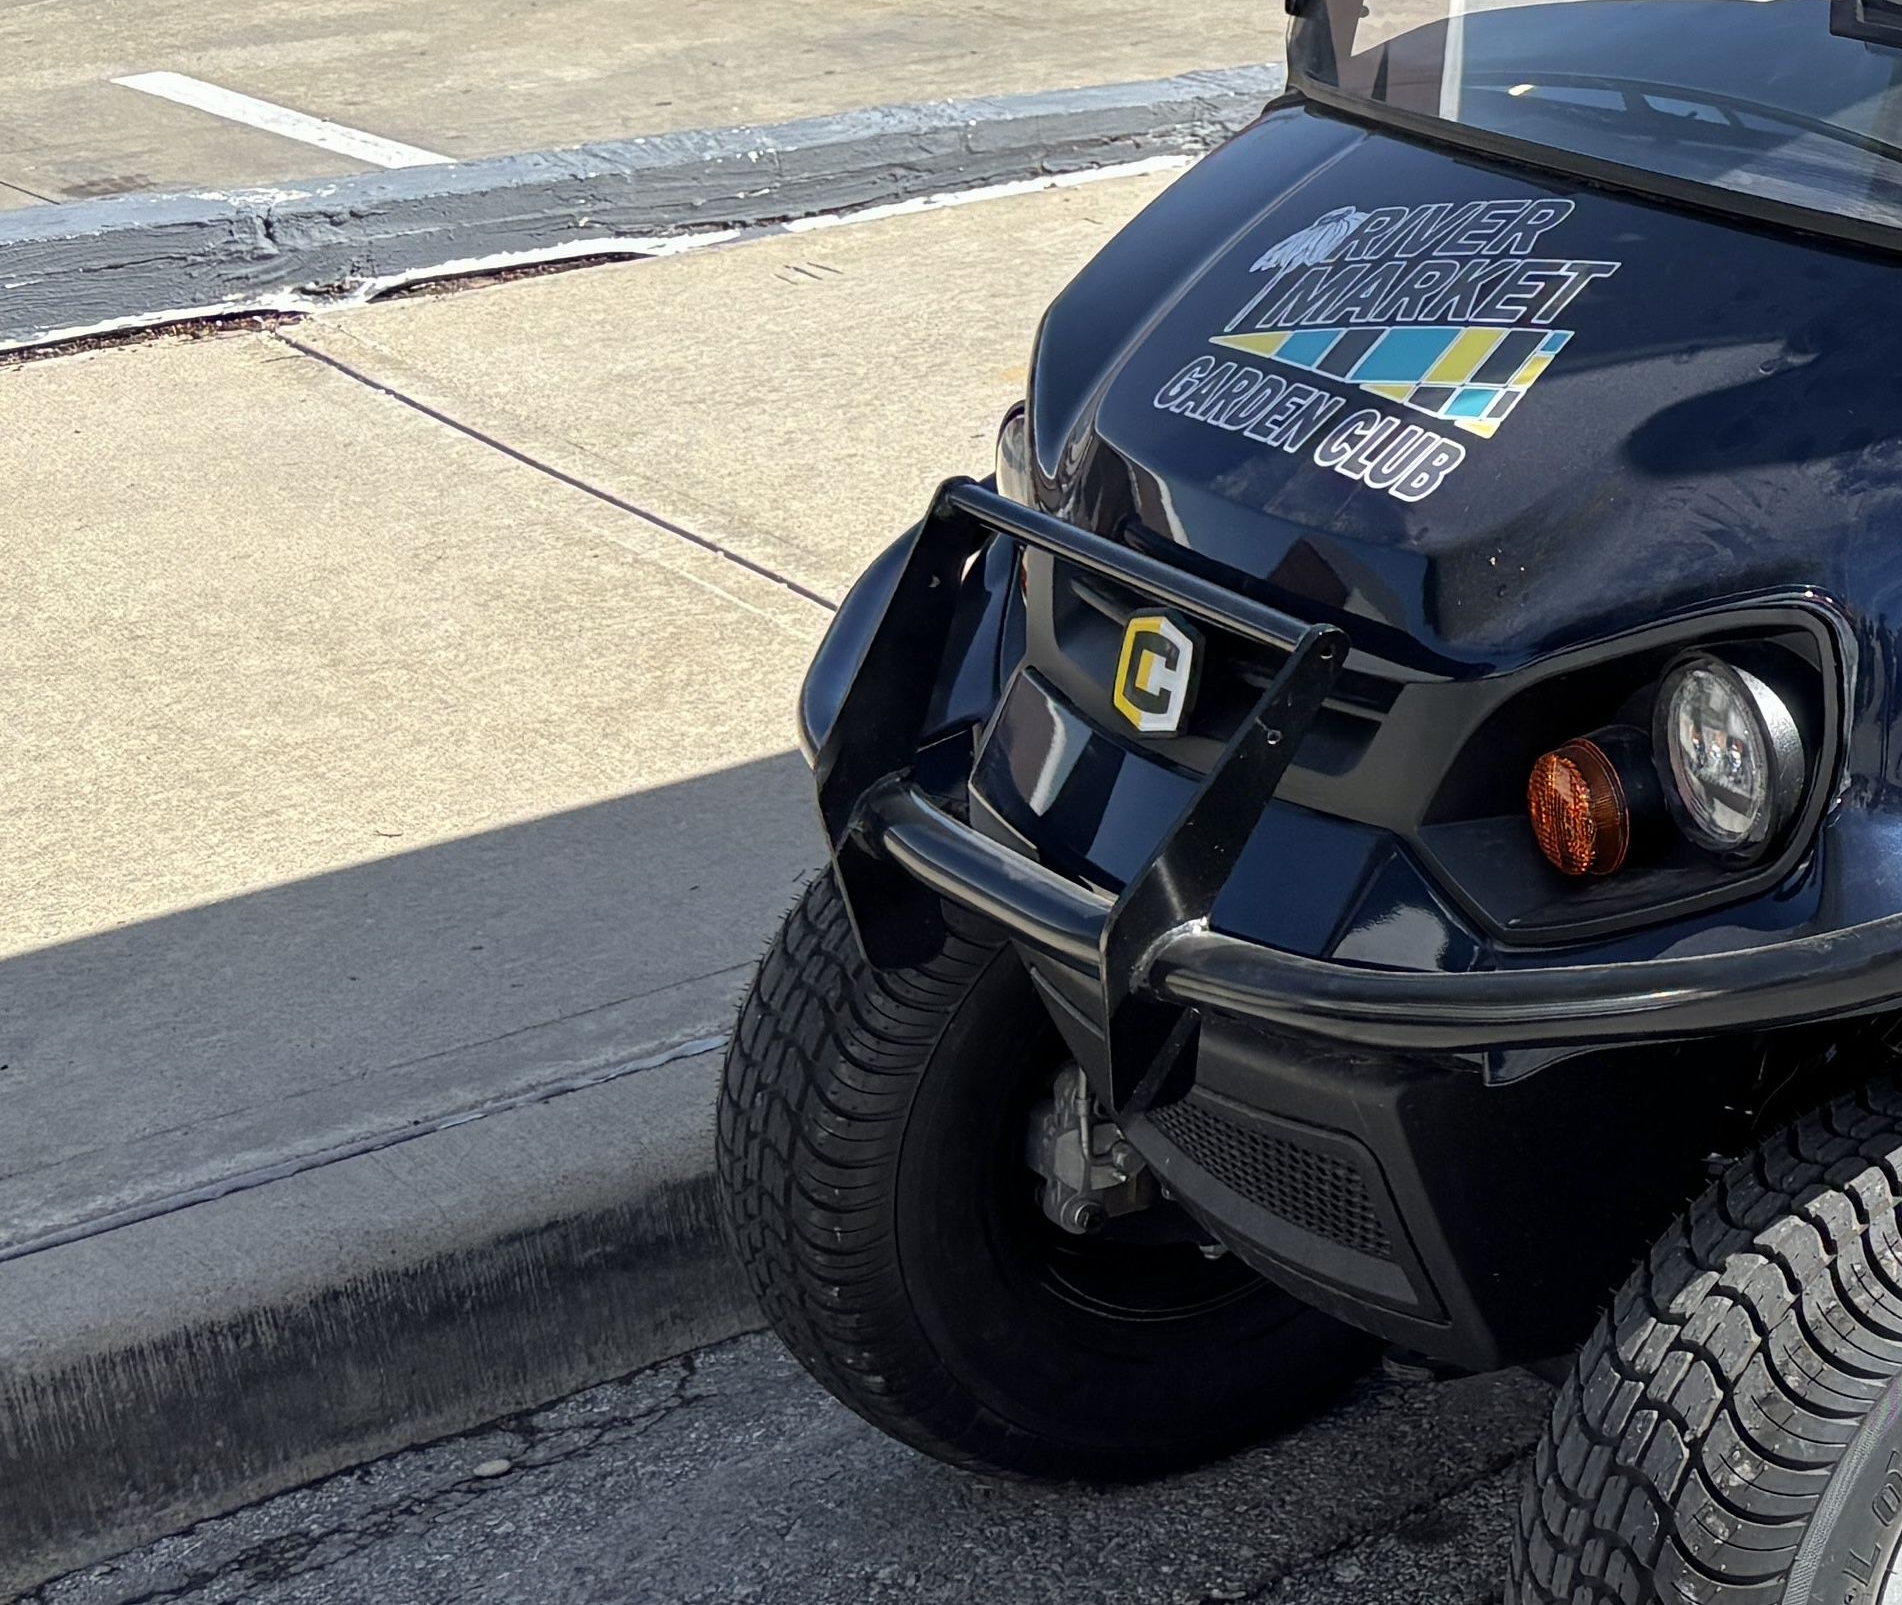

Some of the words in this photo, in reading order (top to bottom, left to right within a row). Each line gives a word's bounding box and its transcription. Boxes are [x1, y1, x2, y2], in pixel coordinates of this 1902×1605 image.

[1329, 198, 1576, 264] RIVER
[1260, 259, 1622, 332] MARKET
[1152, 355, 1348, 454] GARDEN
[1312, 408, 1467, 504] CLUB
